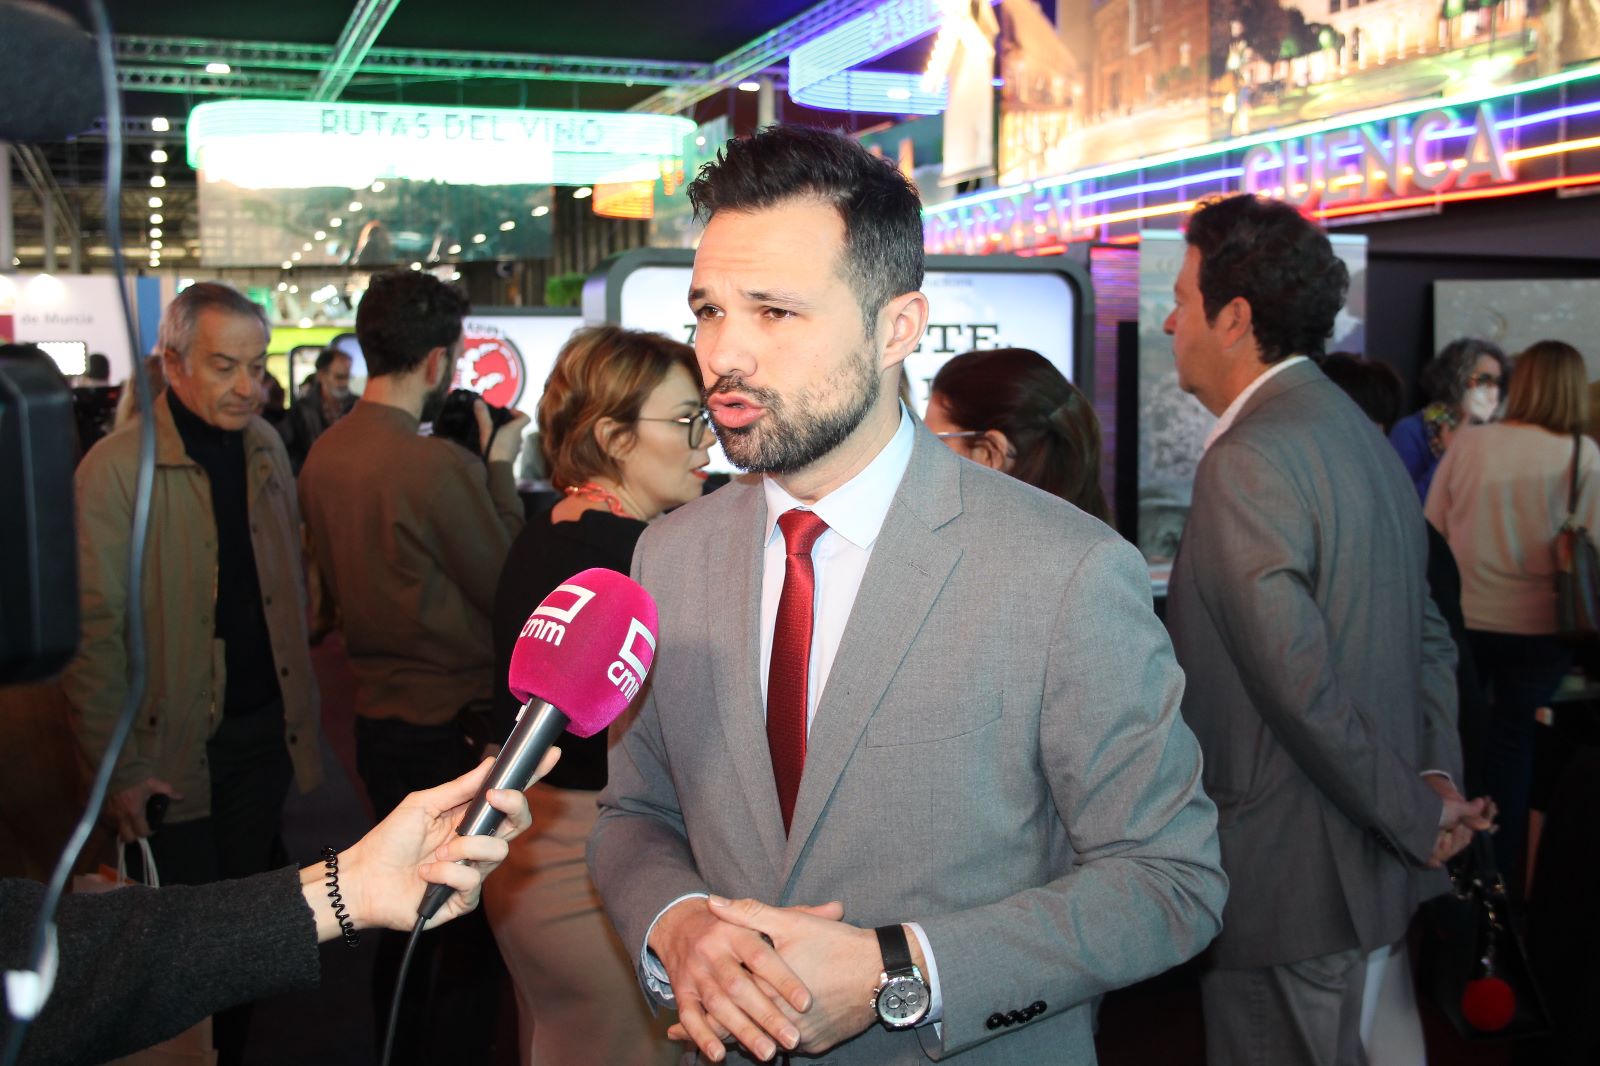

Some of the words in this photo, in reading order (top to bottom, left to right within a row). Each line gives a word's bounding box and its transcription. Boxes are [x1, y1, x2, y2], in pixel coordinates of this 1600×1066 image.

[320, 108, 431, 139] RUTAS
[444, 113, 505, 141] DEL
[518, 115, 603, 146] VINO
[1239, 100, 1516, 205] CUENCA
[519, 618, 567, 647] cmm
